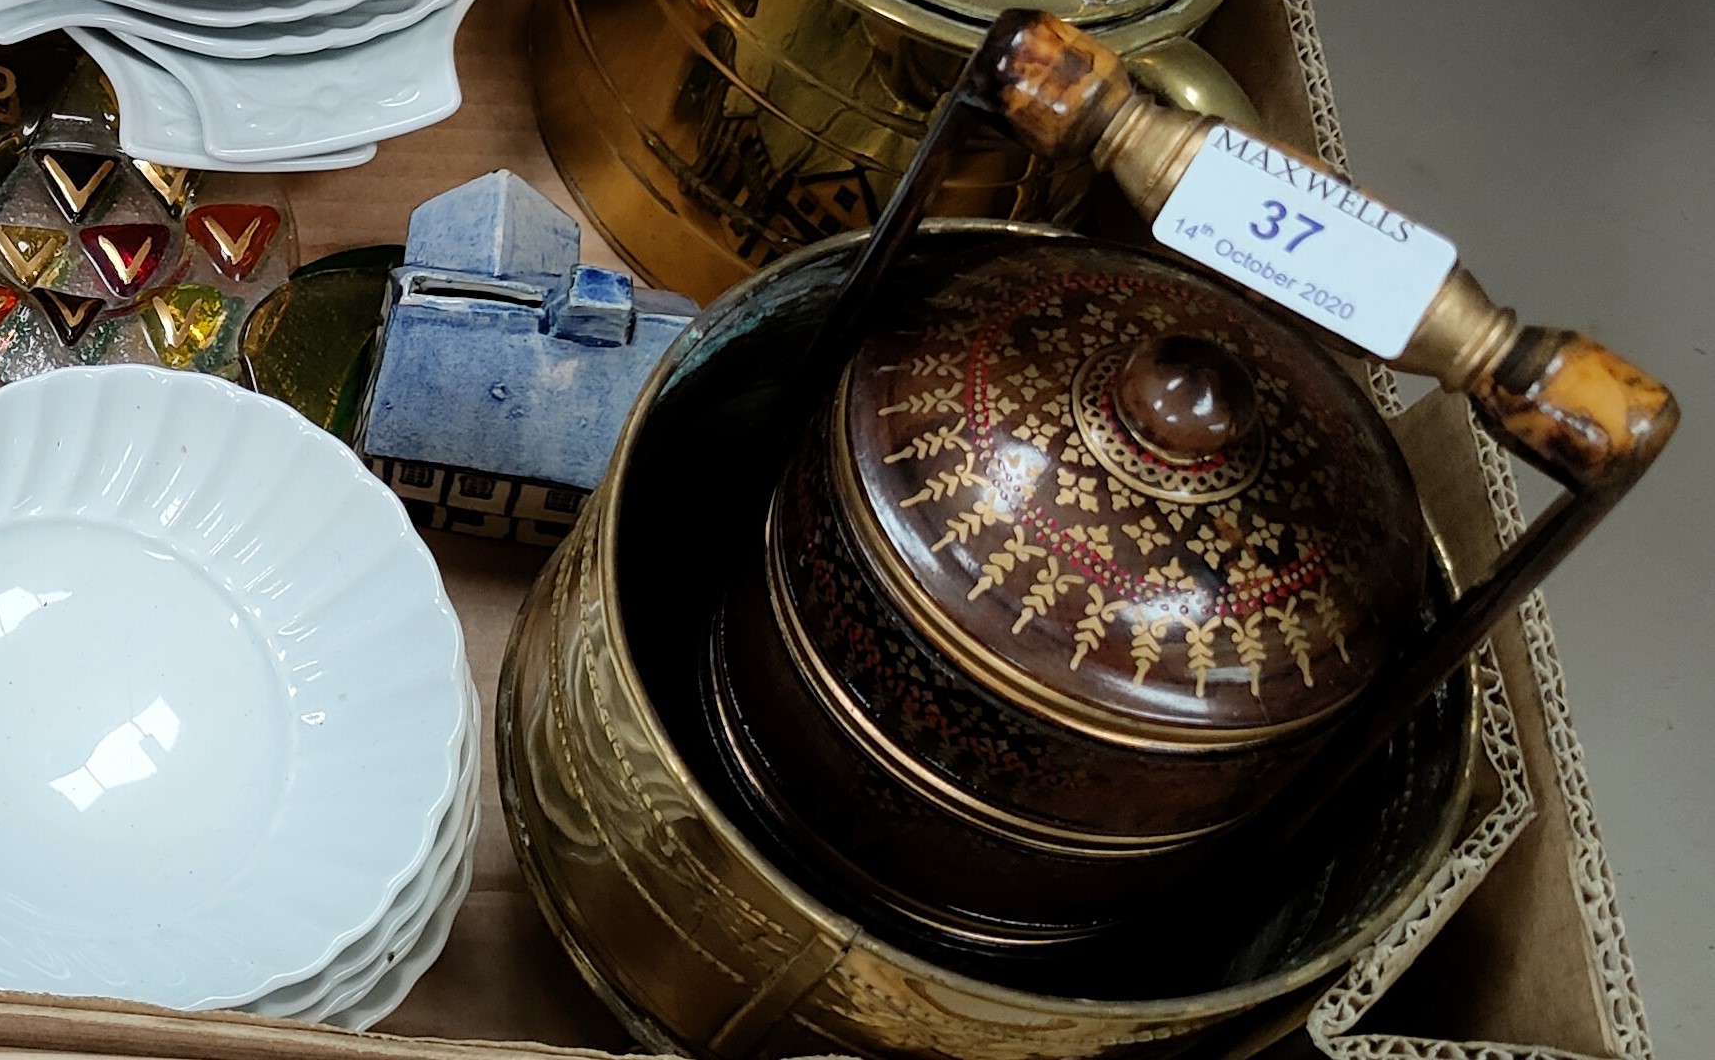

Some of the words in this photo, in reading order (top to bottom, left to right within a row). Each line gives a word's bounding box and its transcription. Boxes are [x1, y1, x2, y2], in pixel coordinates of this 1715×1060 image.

[1211, 129, 1415, 243] MAXWELLS
[1249, 199, 1325, 254] 37
[1173, 218, 1215, 239] 14th
[1214, 239, 1298, 290] October
[1298, 282, 1355, 321] 2020
